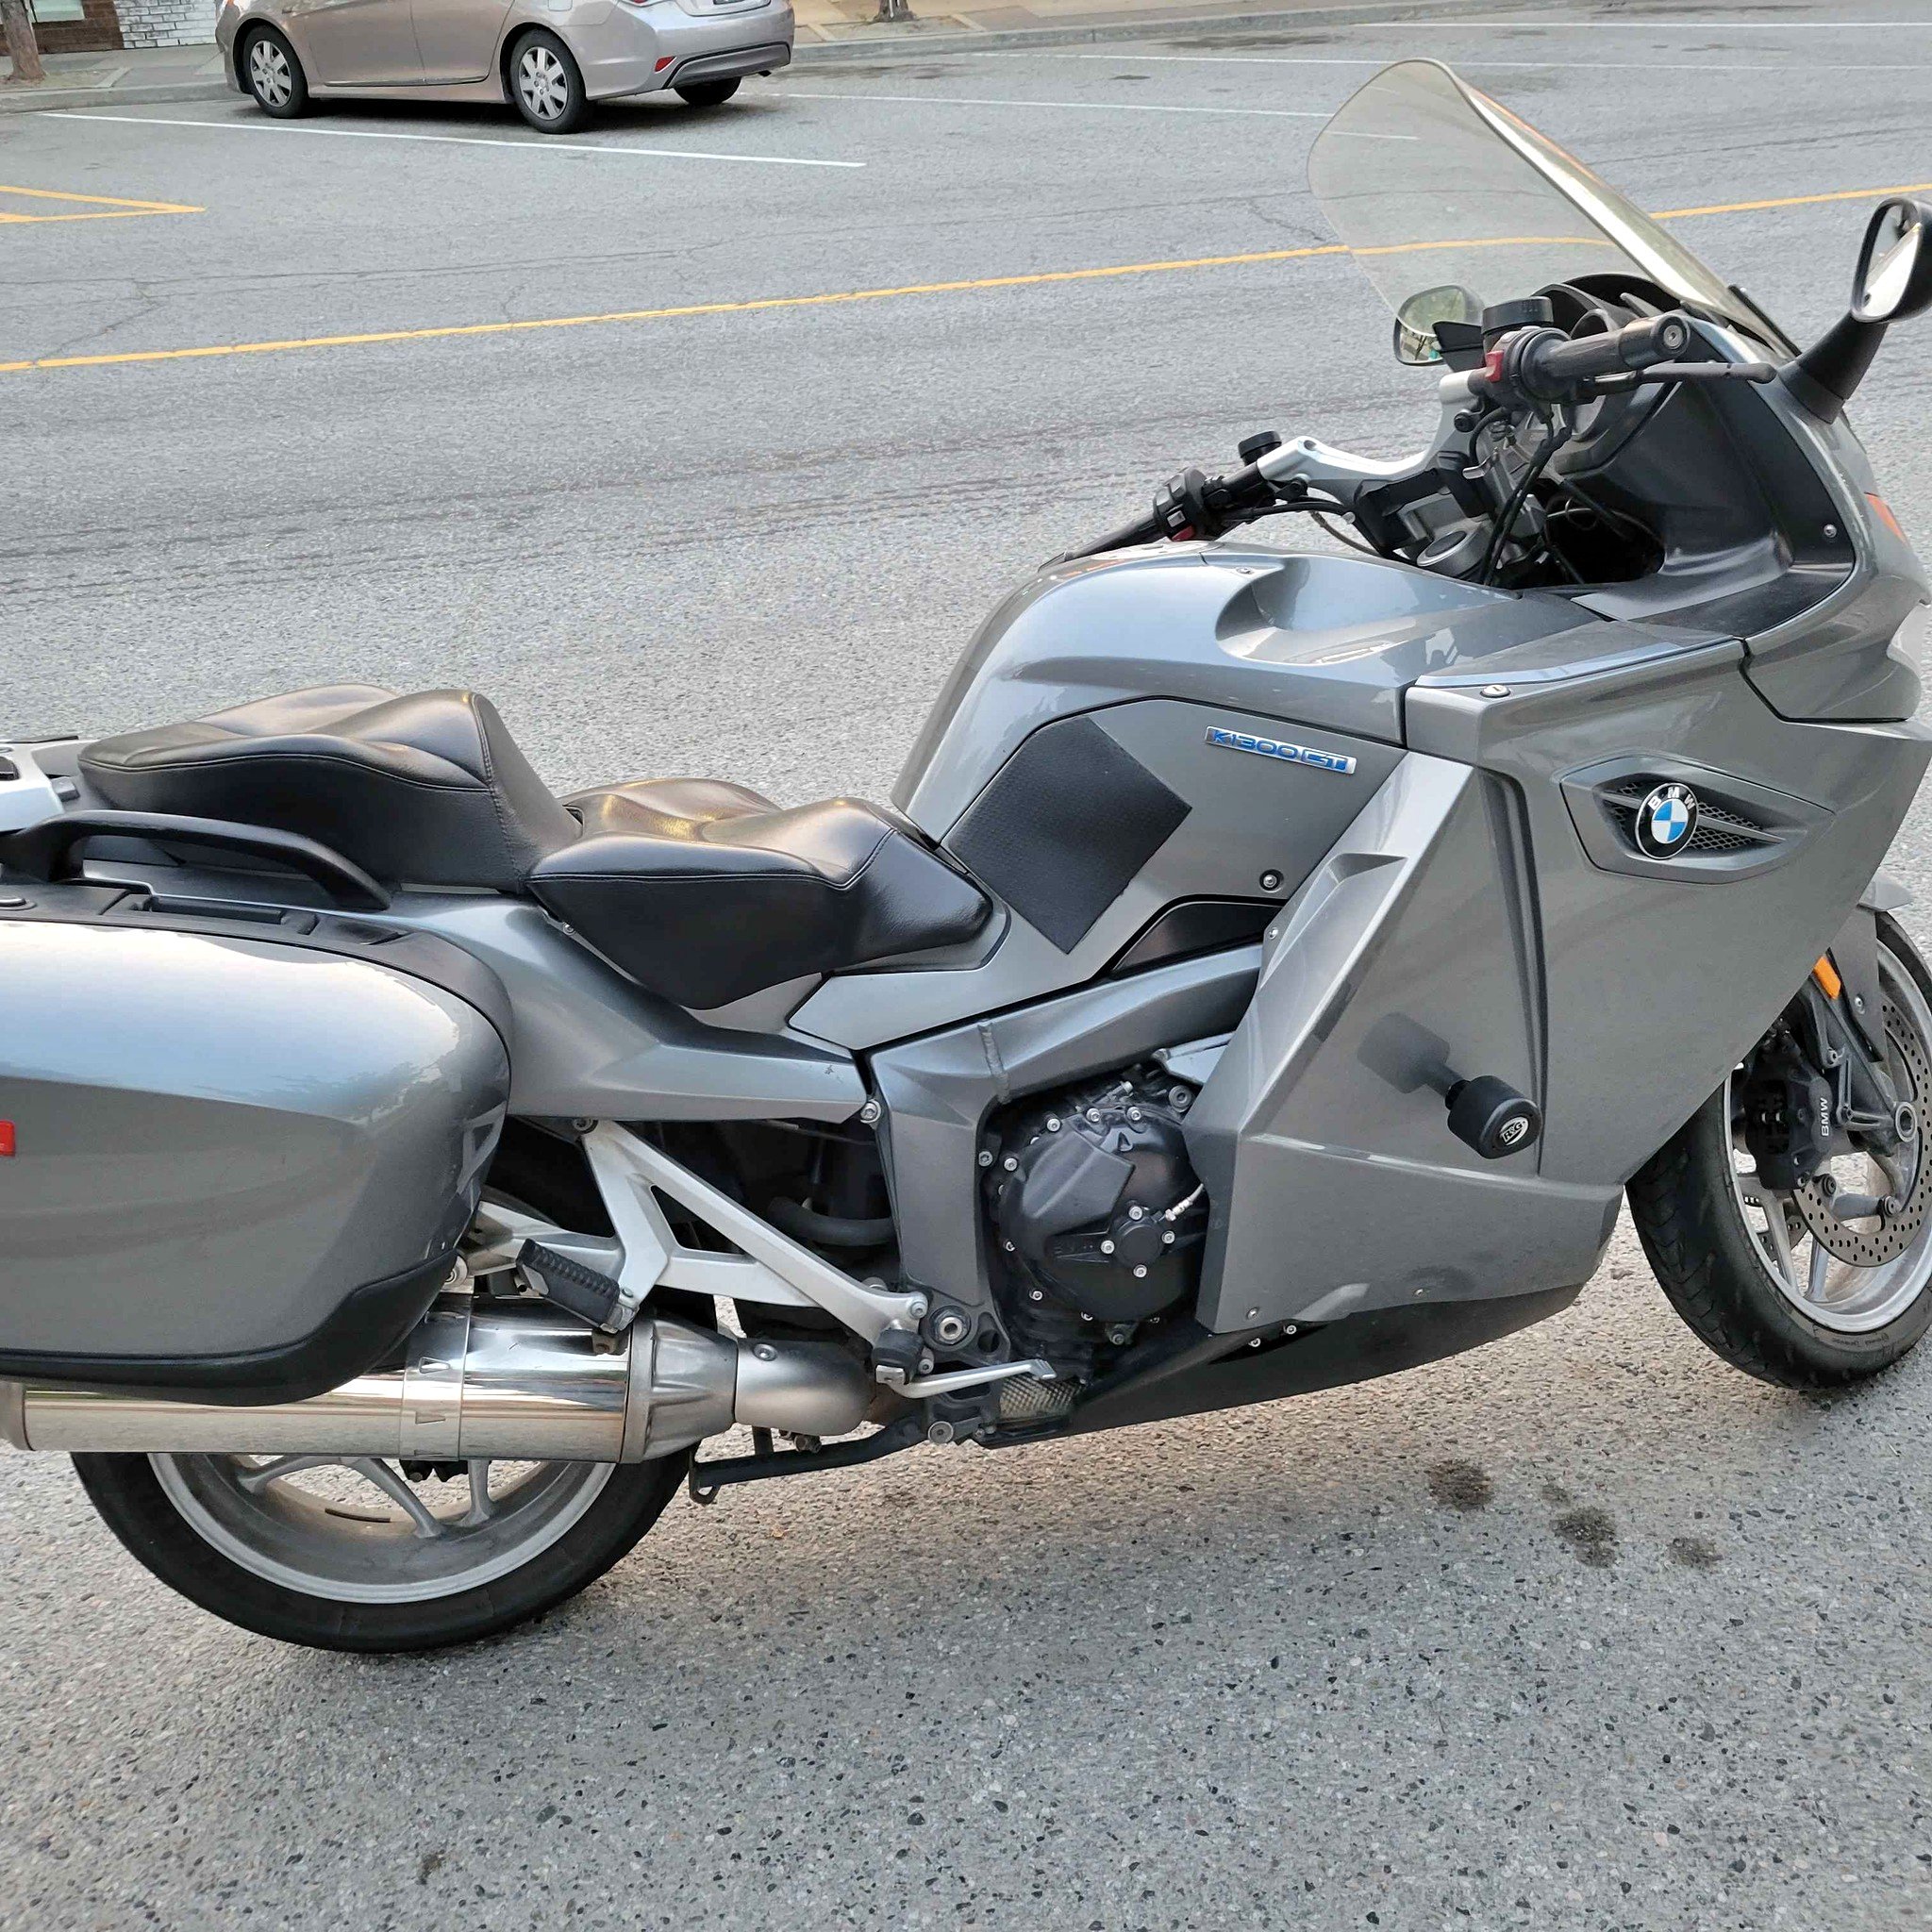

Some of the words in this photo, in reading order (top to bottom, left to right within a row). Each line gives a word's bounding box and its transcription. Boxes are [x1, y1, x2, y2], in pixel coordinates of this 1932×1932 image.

[1648, 787, 1696, 809] BMW
[1821, 1097, 1829, 1136] BMW
[1502, 1121, 1523, 1141] R&G
